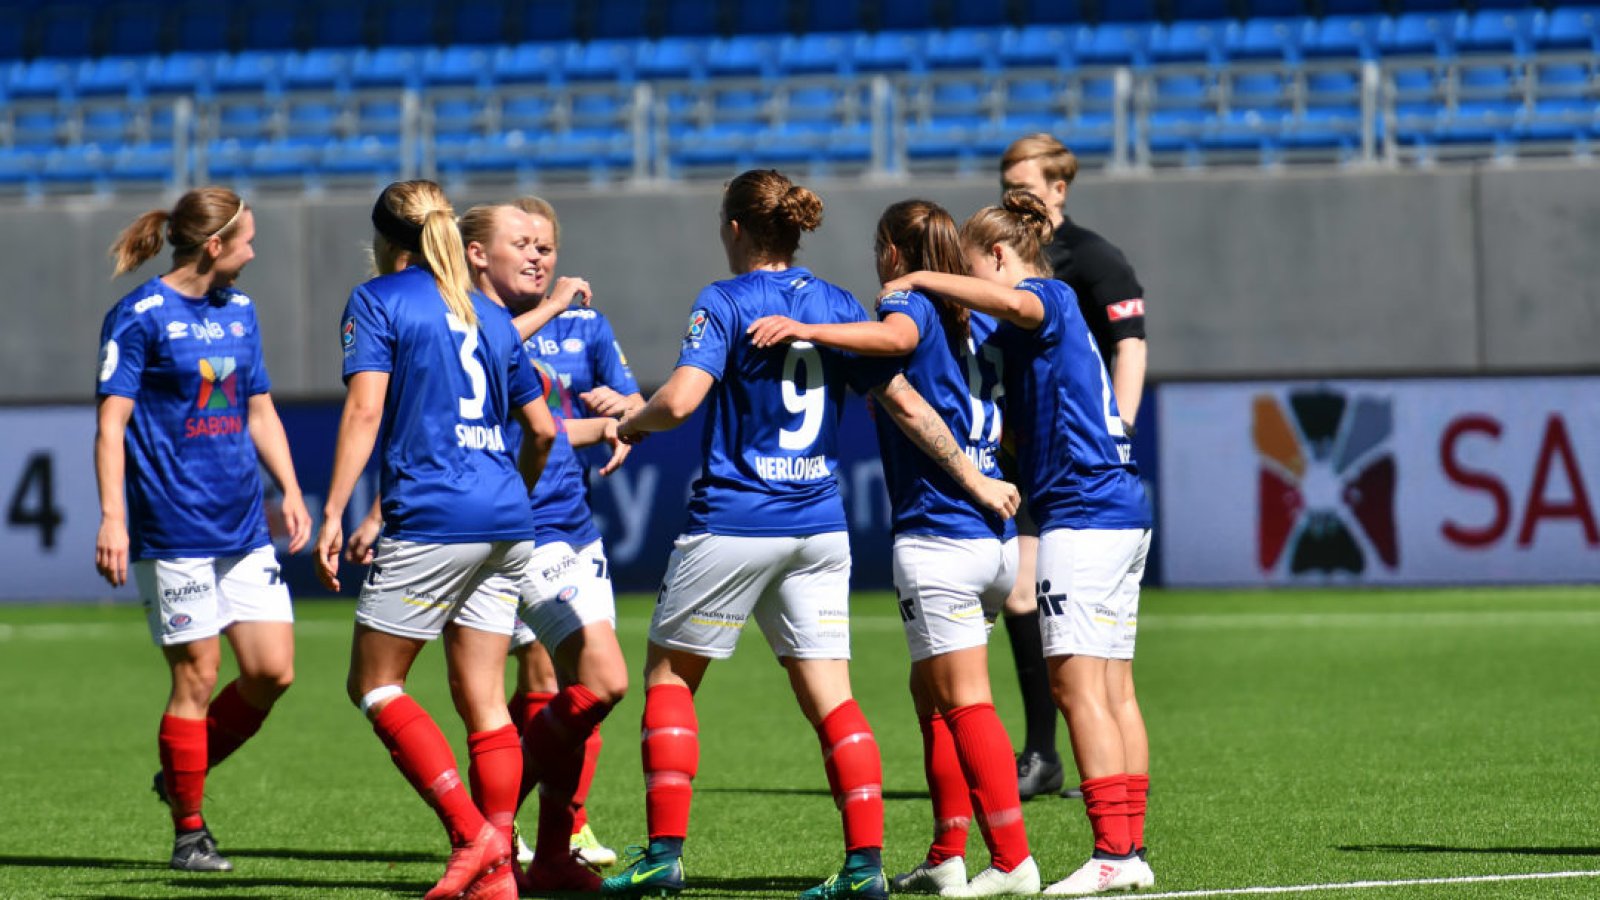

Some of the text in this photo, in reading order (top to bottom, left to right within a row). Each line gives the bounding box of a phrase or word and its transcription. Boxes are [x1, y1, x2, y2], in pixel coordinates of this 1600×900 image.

[778, 340, 826, 451] 9
[7, 451, 66, 551] 4
[1439, 411, 1600, 551] SA
